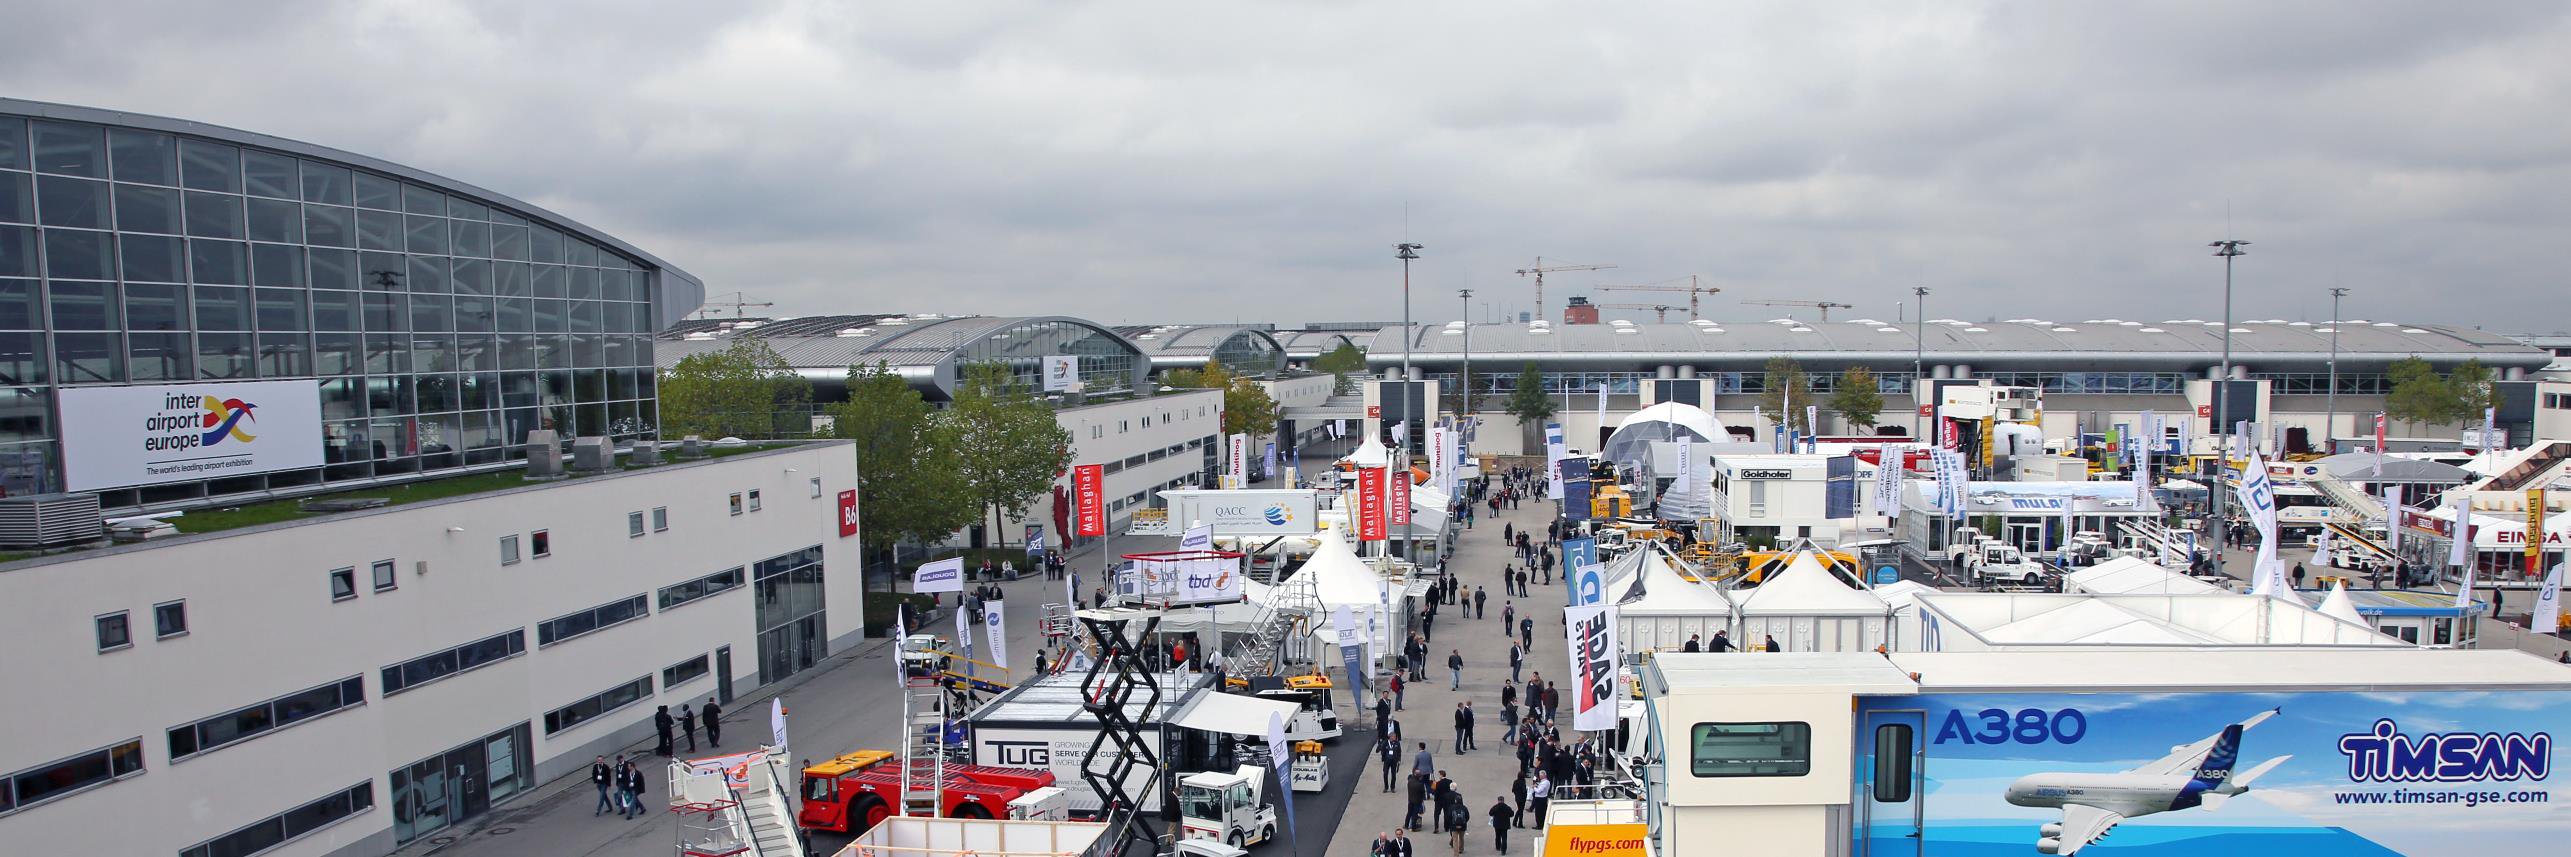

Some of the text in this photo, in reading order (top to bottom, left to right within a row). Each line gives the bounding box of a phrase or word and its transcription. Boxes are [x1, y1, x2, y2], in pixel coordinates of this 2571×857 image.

[166, 392, 201, 410] inter
[146, 412, 200, 433] airport
[145, 434, 200, 451] europe
[147, 458, 253, 475] The world's leading airport exhibition
[1743, 470, 1790, 478] Goldhofer
[1081, 468, 1093, 532] Mallaghan
[1364, 471, 1376, 537] Mallaghan
[1394, 473, 1404, 523] Mallaghan
[2012, 499, 2062, 508] MULA
[845, 505, 856, 526] B6
[1216, 506, 1247, 517] QACC
[1188, 573, 1212, 589] tbd
[1933, 708, 2087, 745] A380
[985, 740, 1049, 765] TUG
[1055, 741, 1091, 749] GROWING
[2197, 769, 2229, 779] A380
[2335, 789, 2548, 807] www.timsan-gse.com
[1570, 837, 1645, 853] flypgs.com
